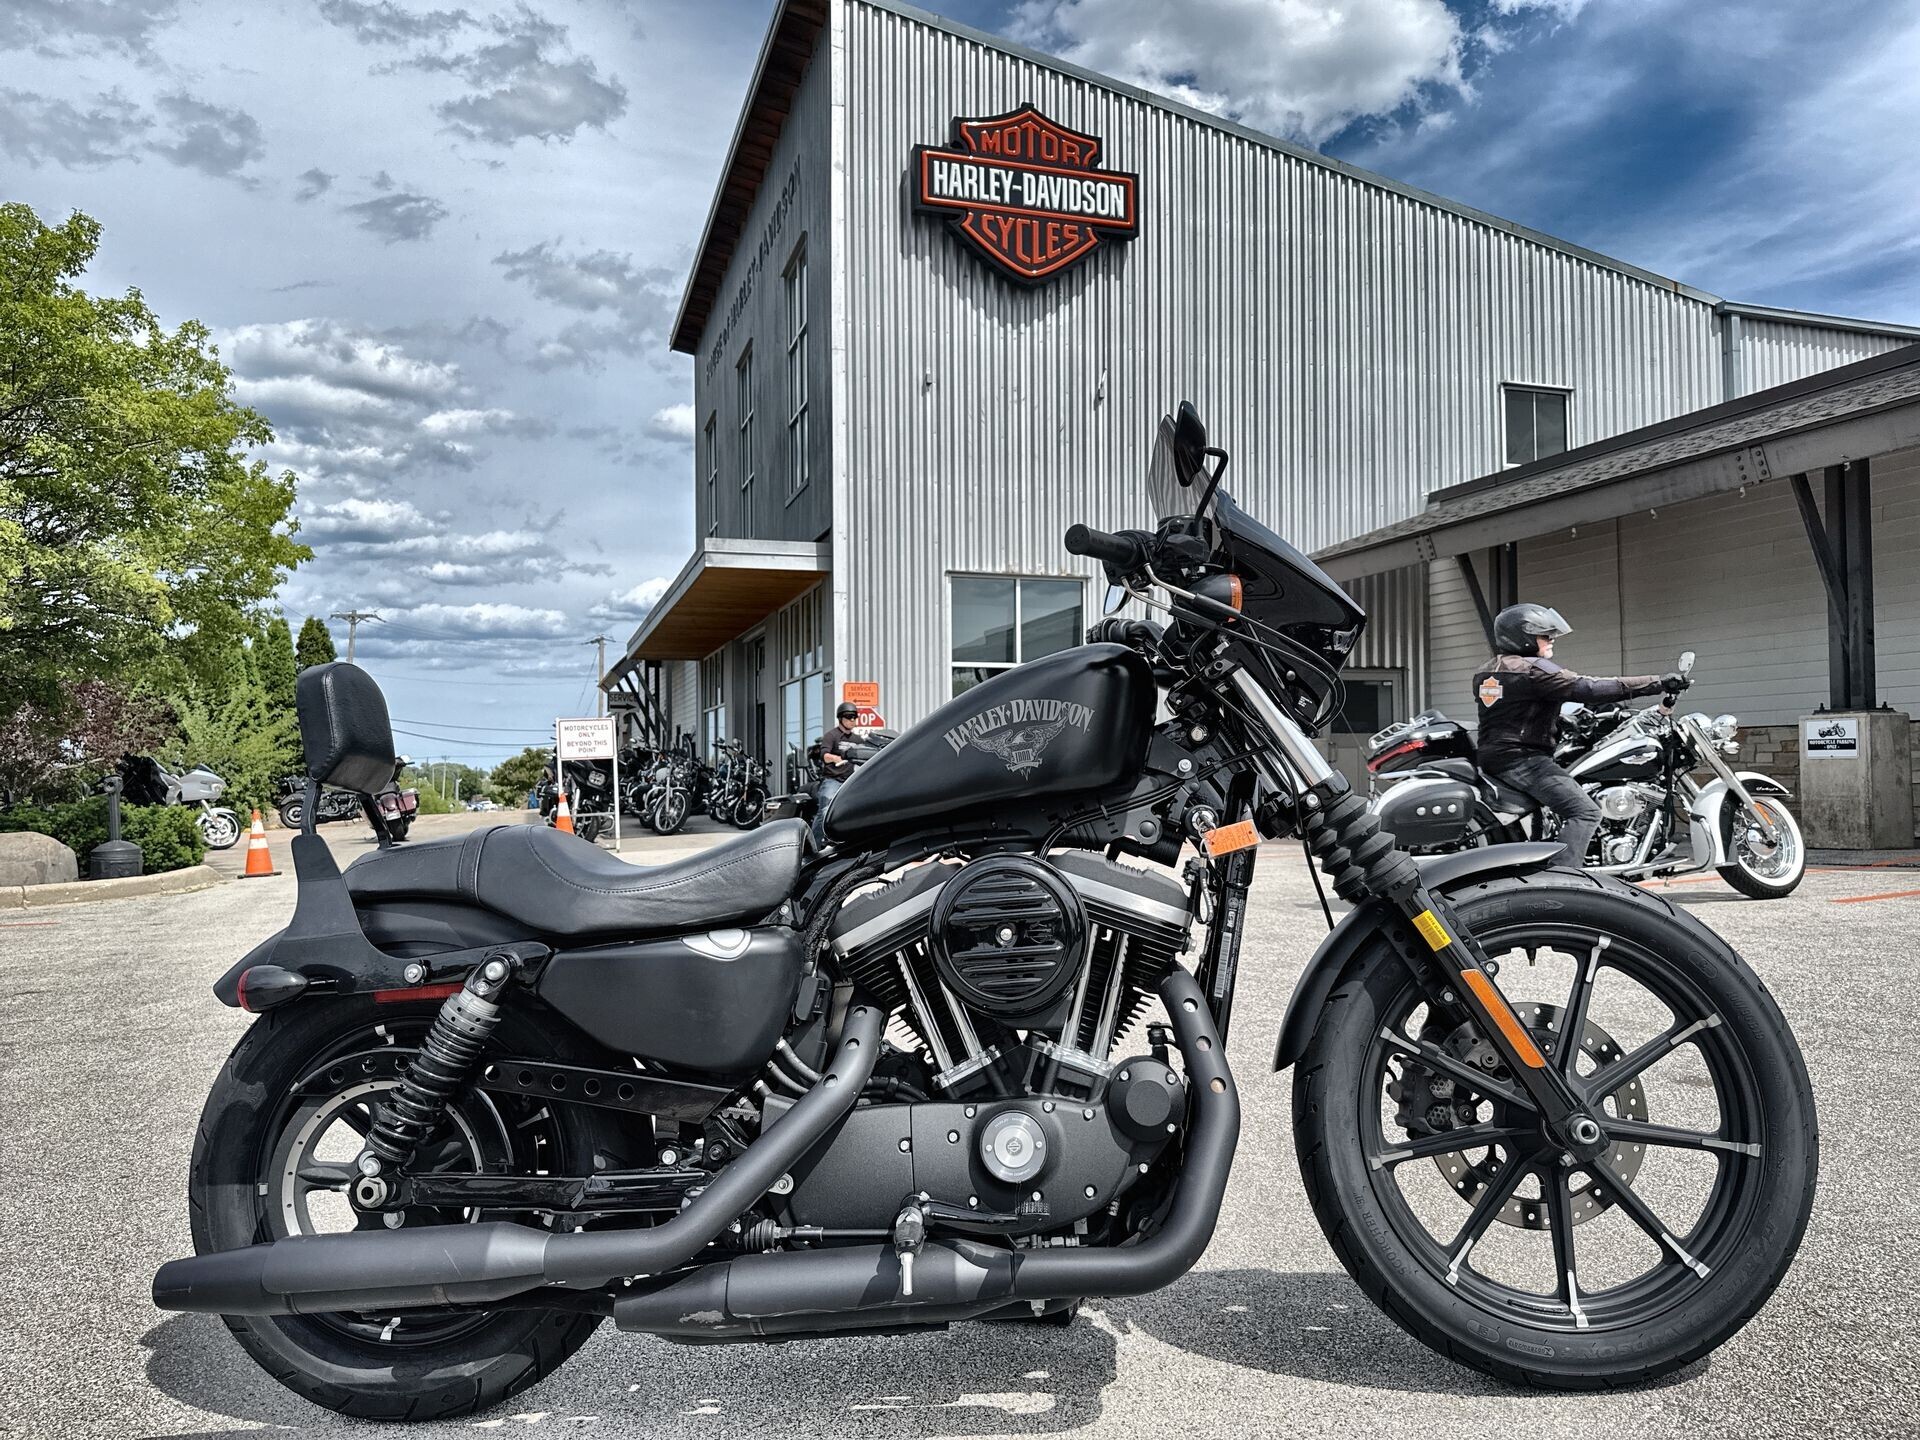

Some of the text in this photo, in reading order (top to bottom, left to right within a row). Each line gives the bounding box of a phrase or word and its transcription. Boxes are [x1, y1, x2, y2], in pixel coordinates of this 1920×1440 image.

[980, 120, 1081, 167] MOTOR
[932, 160, 1125, 219] HARLEY-DAVIDSON
[981, 213, 1081, 264] CYCLES
[1362, 1210, 1409, 1275] SCORCHER
